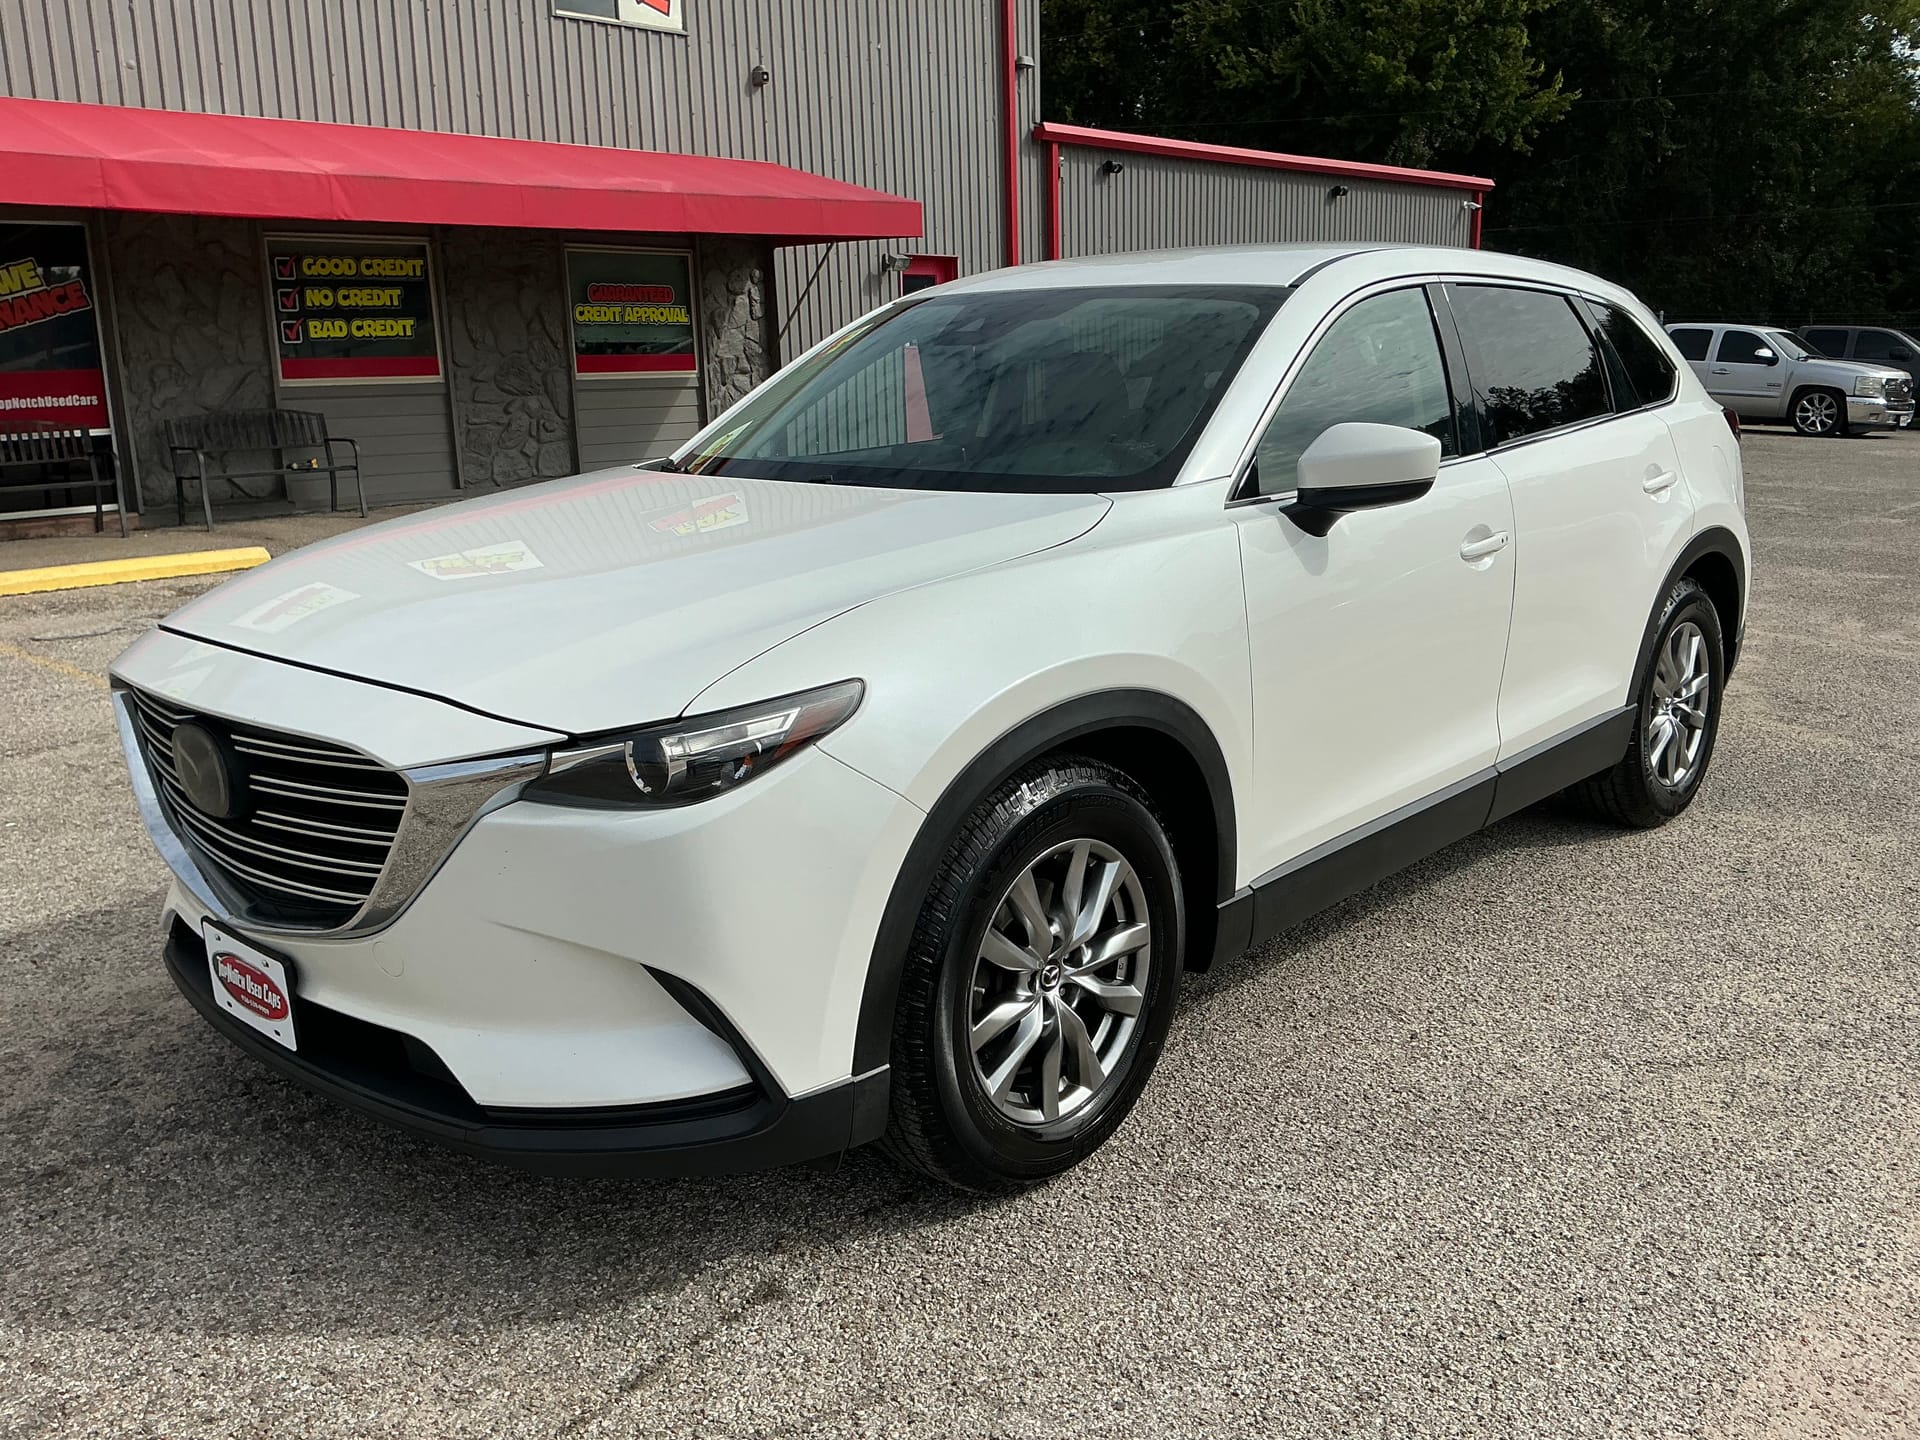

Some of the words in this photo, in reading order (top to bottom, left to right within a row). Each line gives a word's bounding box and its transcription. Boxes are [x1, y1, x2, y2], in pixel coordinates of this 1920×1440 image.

[303, 258, 357, 276] GOOD
[360, 258, 424, 276] CREDIT
[305, 288, 334, 307] NO
[337, 288, 401, 307] CREDIT
[590, 285, 673, 303] GUARANTEED
[575, 305, 622, 322] CREDIT
[624, 306, 690, 323] APPROVAL
[308, 319, 348, 339] BAD
[351, 319, 414, 337] CREDIT
